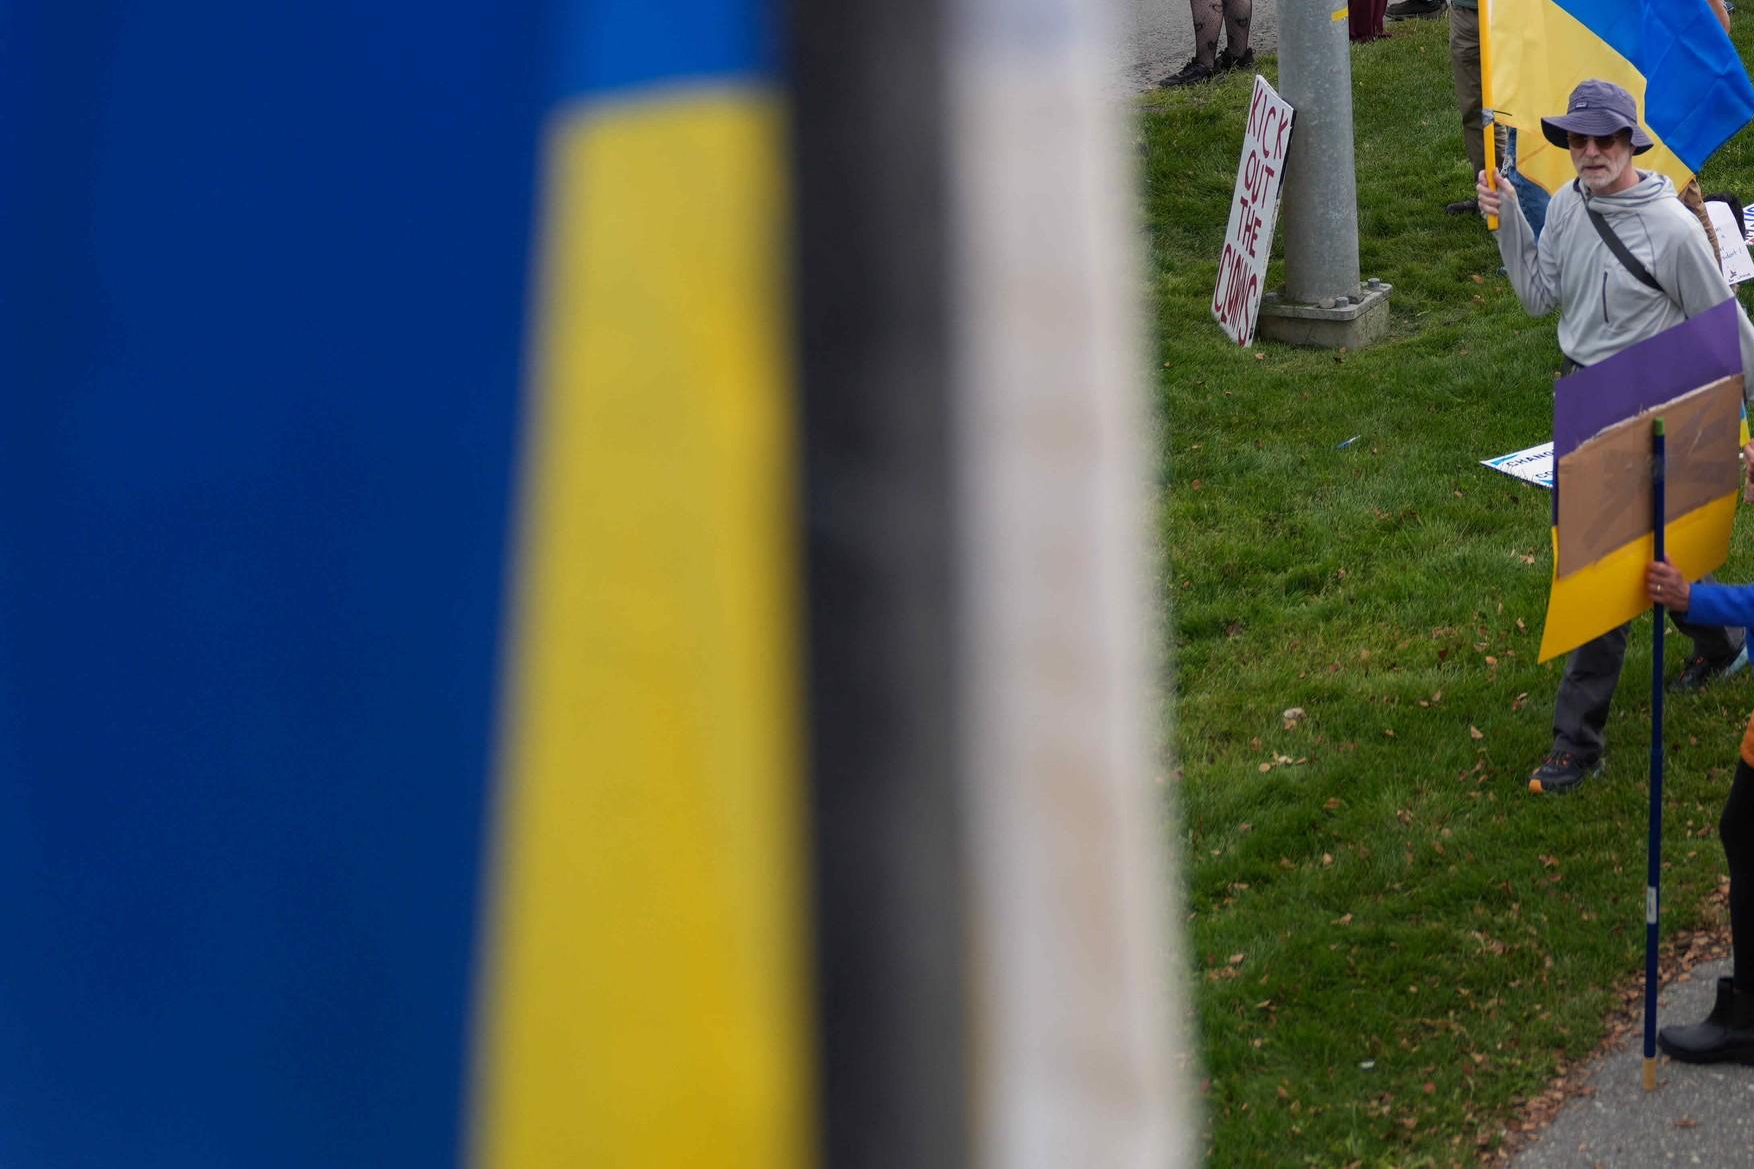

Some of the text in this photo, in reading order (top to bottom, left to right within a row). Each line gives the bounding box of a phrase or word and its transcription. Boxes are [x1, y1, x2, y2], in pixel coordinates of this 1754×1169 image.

[1248, 80, 1289, 160] KICK
[1244, 149, 1275, 209] OUT
[1236, 195, 1262, 259] THE
[1214, 243, 1258, 348] CLOWNS
[1506, 449, 1554, 467] CHANG
